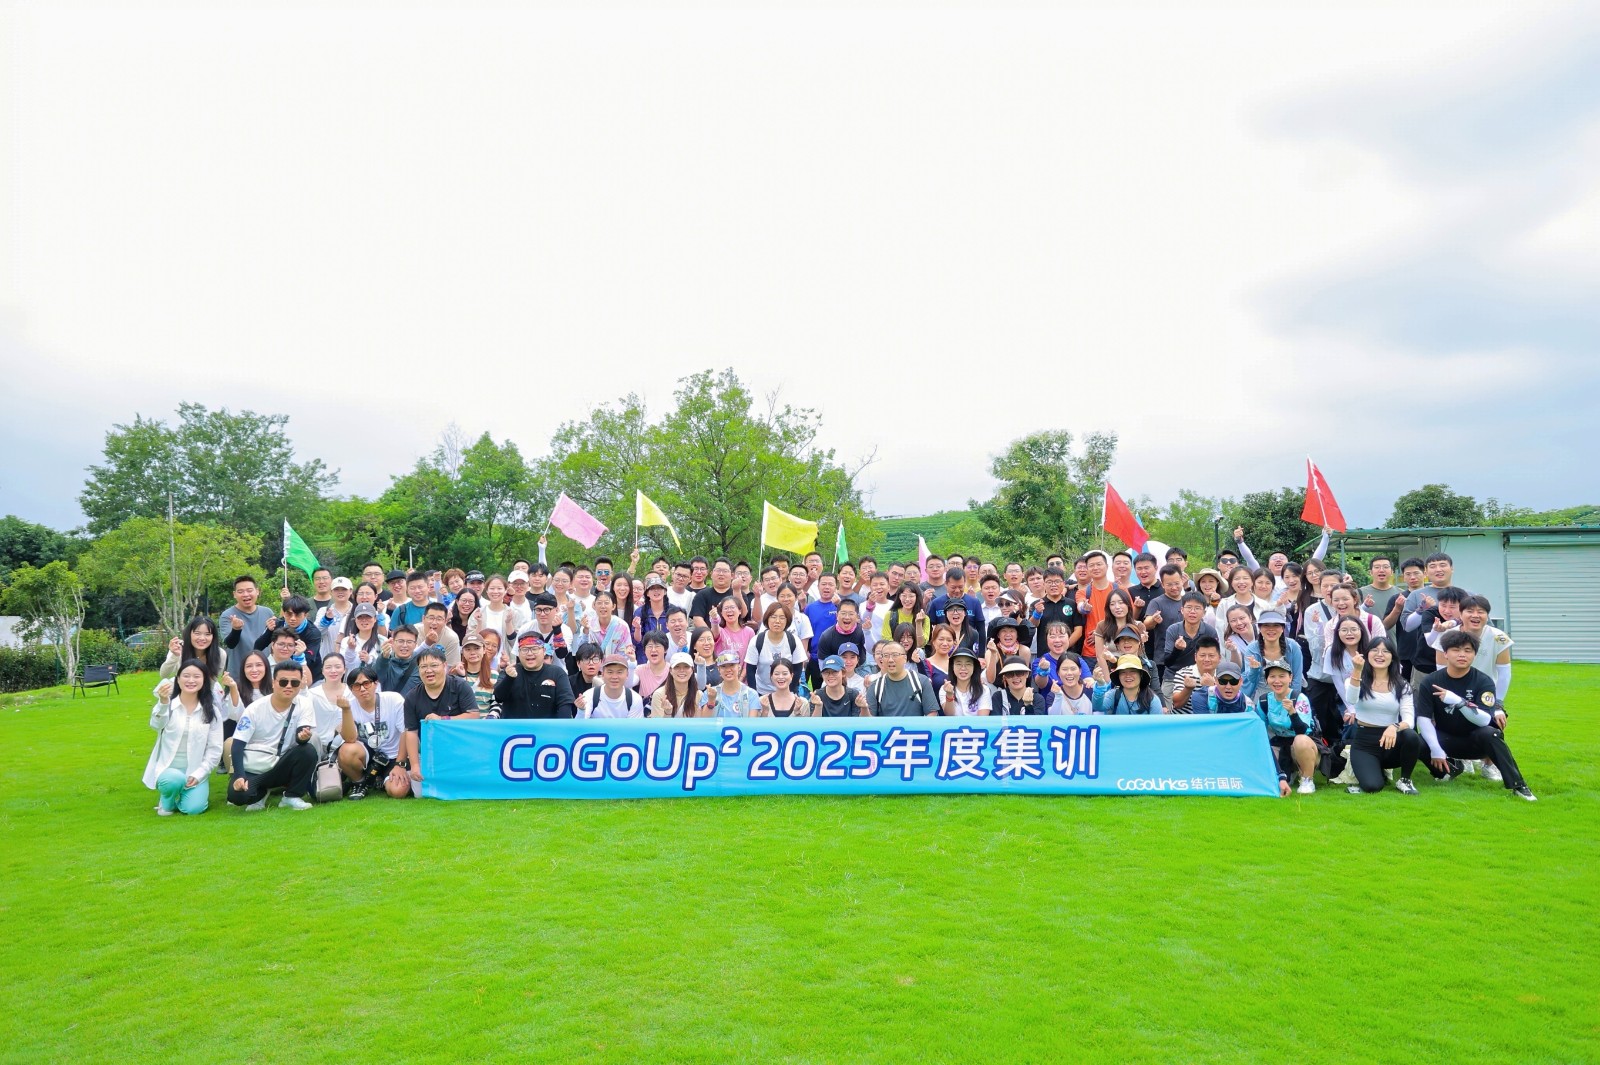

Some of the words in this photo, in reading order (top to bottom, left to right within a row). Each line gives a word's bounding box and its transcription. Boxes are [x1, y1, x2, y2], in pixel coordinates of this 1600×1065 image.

[747, 725, 1100, 781] 2025年度集训
[1191, 777, 1244, 790] 结行国际
